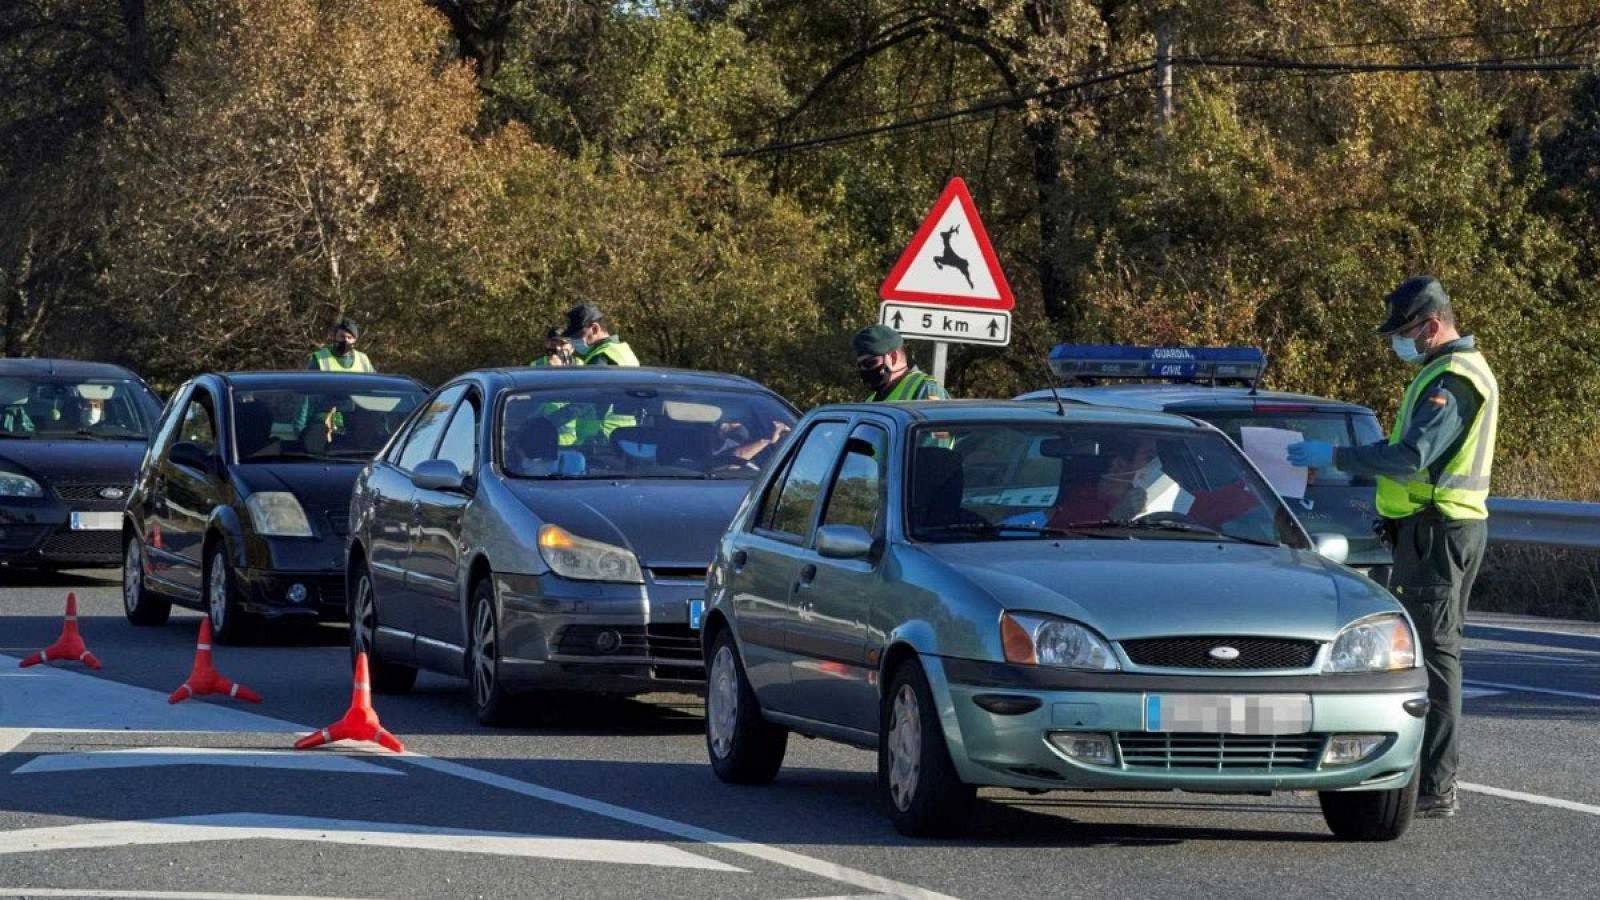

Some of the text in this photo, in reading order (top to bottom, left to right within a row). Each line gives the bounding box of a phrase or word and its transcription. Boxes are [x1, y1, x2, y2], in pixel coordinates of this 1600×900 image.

[922, 313, 969, 332] 5 km
[1154, 348, 1191, 359] GUARDIA
[1161, 364, 1182, 376] CIVIL
